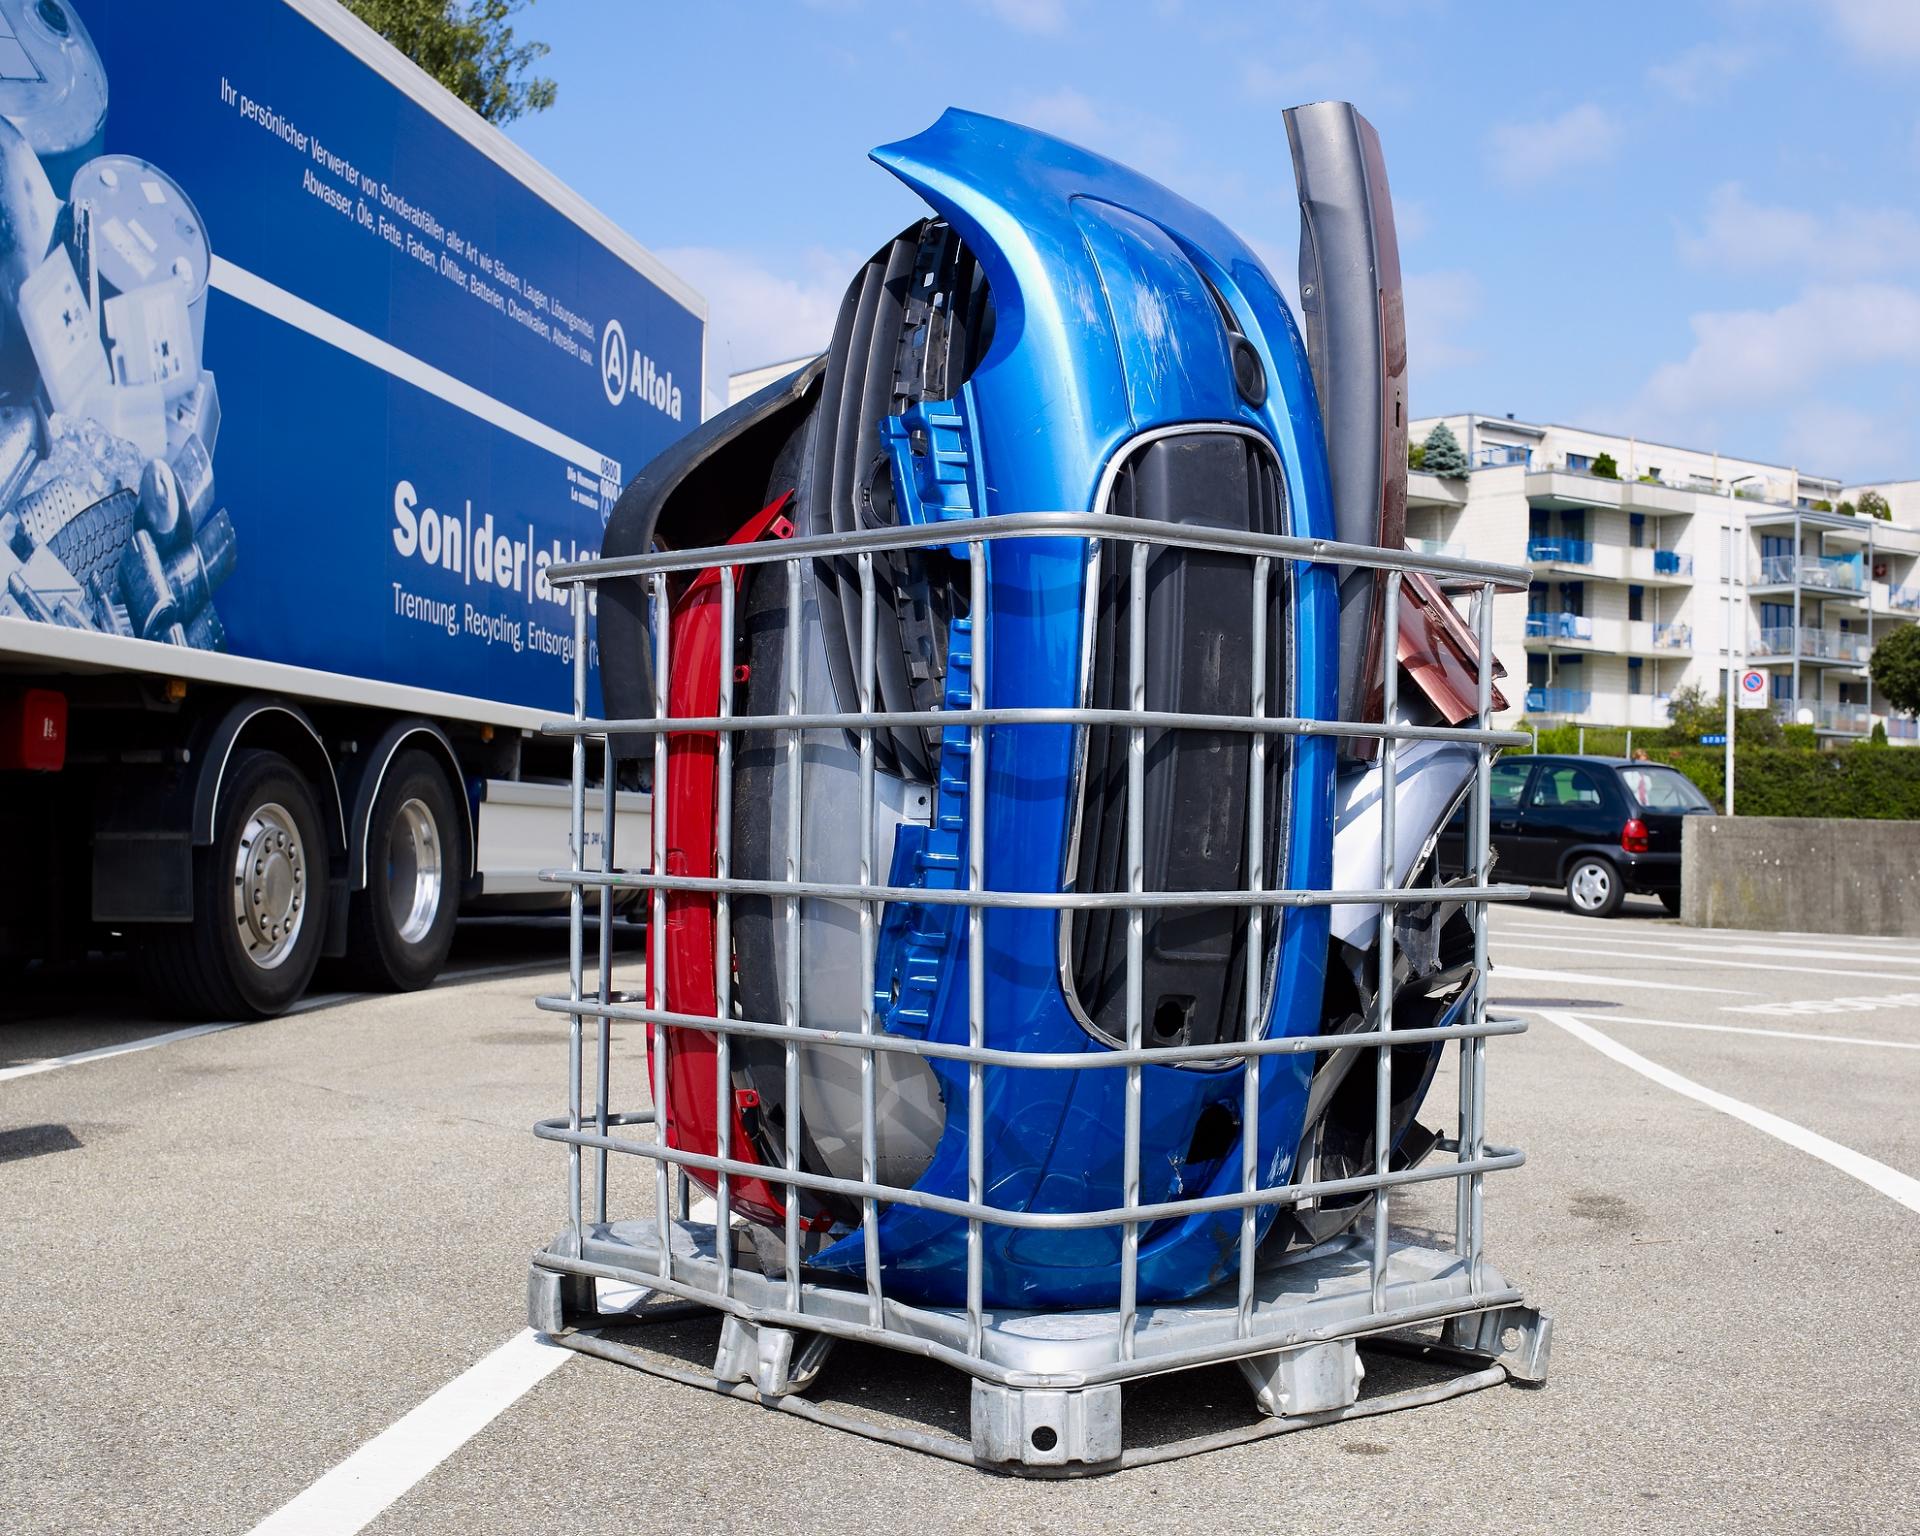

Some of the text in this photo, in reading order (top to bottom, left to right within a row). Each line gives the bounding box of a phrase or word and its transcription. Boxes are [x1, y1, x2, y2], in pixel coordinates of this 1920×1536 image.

[221, 76, 237, 107] Ihr
[240, 94, 309, 153] persönlicher
[311, 136, 359, 186] Verwerter
[361, 174, 378, 200] von
[380, 183, 445, 243] Sonderabfällen
[446, 230, 465, 255] aller
[465, 241, 478, 265] Art
[479, 253, 493, 275] wie
[494, 259, 522, 295] Säuren,
[523, 278, 550, 314] Laugen,
[303, 168, 354, 222] Abwasser,
[357, 197, 376, 235] Öle,
[378, 215, 404, 253] Fette,
[406, 233, 438, 273] Farben,
[470, 273, 506, 315] Batterien,
[508, 298, 551, 343] Chemikalien,
[629, 349, 681, 422] Altola
[600, 457, 618, 481] 0800
[392, 582, 460, 636] Trennung,
[464, 603, 525, 653] Recycling,
[527, 621, 575, 665] Entsorgu
